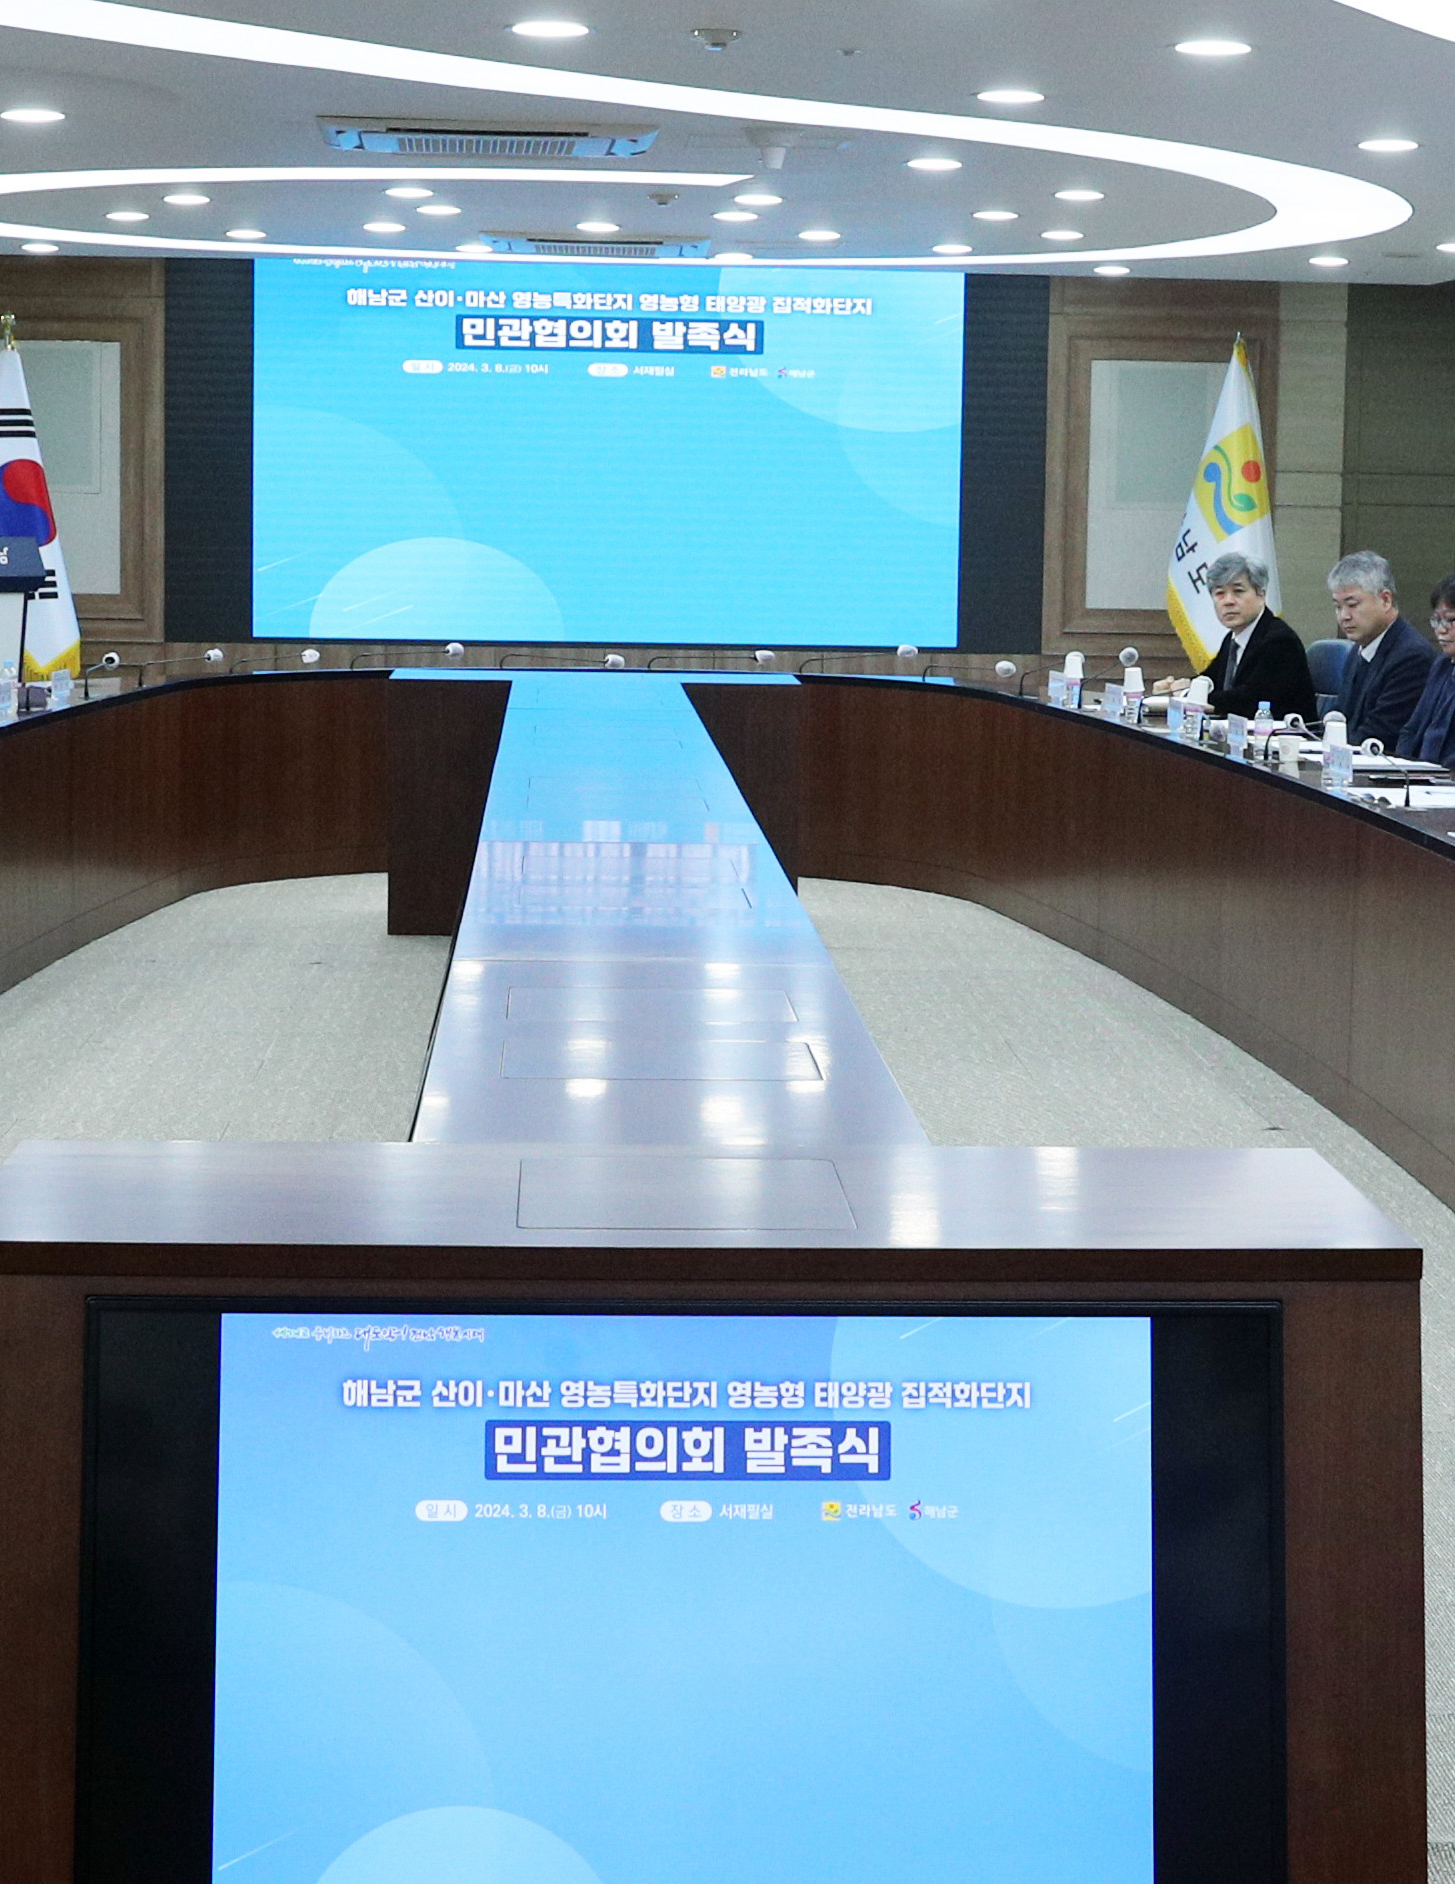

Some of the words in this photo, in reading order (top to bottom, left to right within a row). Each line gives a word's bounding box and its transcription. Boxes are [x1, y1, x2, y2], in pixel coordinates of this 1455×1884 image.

[346, 288, 407, 307] 해남군
[512, 291, 633, 311] 영농특화단지
[639, 293, 699, 313] 영농형
[705, 295, 767, 314] 태양광
[772, 296, 874, 315] 집적화단지
[461, 317, 638, 349] 민관협의회
[651, 320, 756, 351] 발족식
[524, 364, 549, 375] 10시
[342, 1379, 422, 1408] 해남군
[431, 1379, 552, 1408] 산이·마산
[559, 1380, 718, 1409] 영농특화단지
[726, 1380, 805, 1409] 영농형
[814, 1381, 893, 1409] 태양광
[901, 1381, 1031, 1409] 집적화단지
[494, 1425, 726, 1474] 민관협의회
[744, 1426, 880, 1474] 발족식
[474, 1503, 515, 1519] 2024.
[577, 1503, 607, 1520] 10시
[718, 1502, 774, 1520] 서재필실
[845, 1503, 897, 1519] 전라남도
[923, 1504, 960, 1519] 해남군
